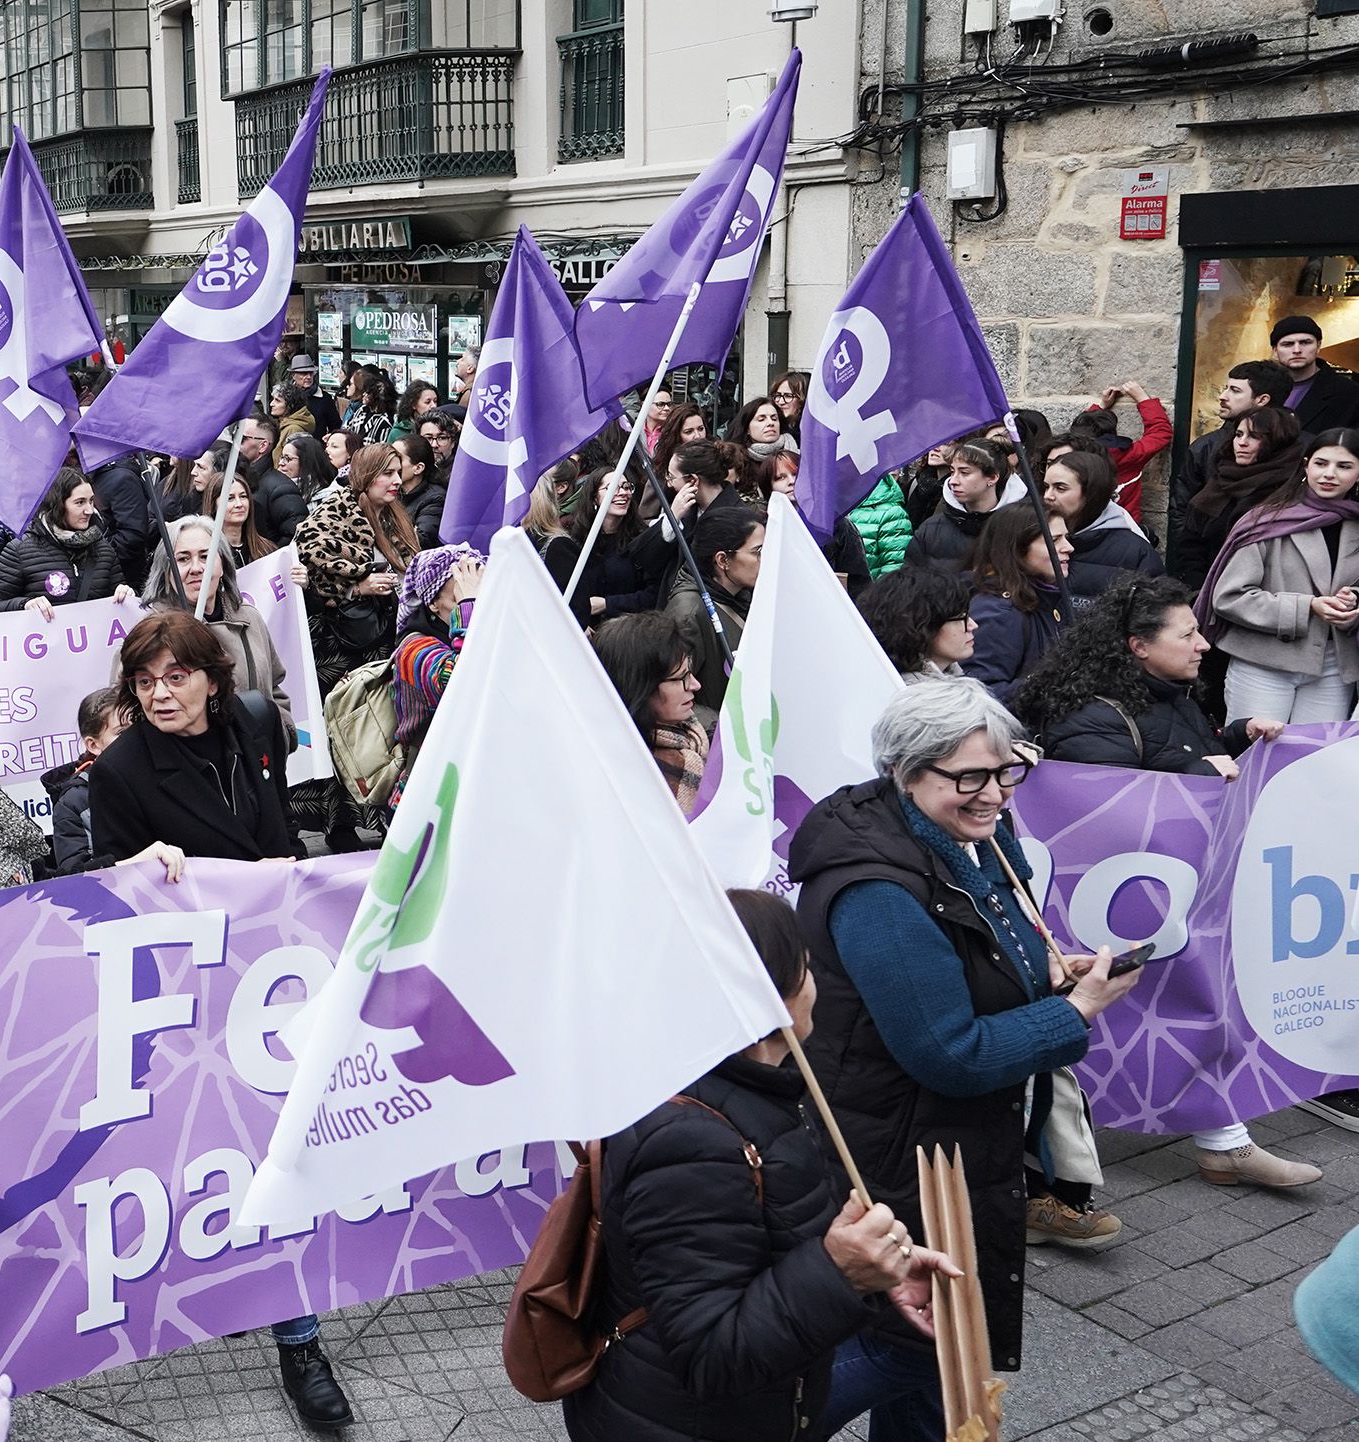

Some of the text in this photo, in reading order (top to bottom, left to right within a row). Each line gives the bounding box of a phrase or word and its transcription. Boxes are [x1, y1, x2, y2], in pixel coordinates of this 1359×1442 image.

[1125, 200, 1163, 209] Alarma
[298, 221, 396, 252] OBILIARIA
[341, 264, 422, 283] PEDROSA
[365, 312, 428, 331] PEDROSA
[1272, 984, 1326, 1004] BLOQUE
[78, 908, 337, 1132] Fe
[1274, 1015, 1324, 1035] GALEGO
